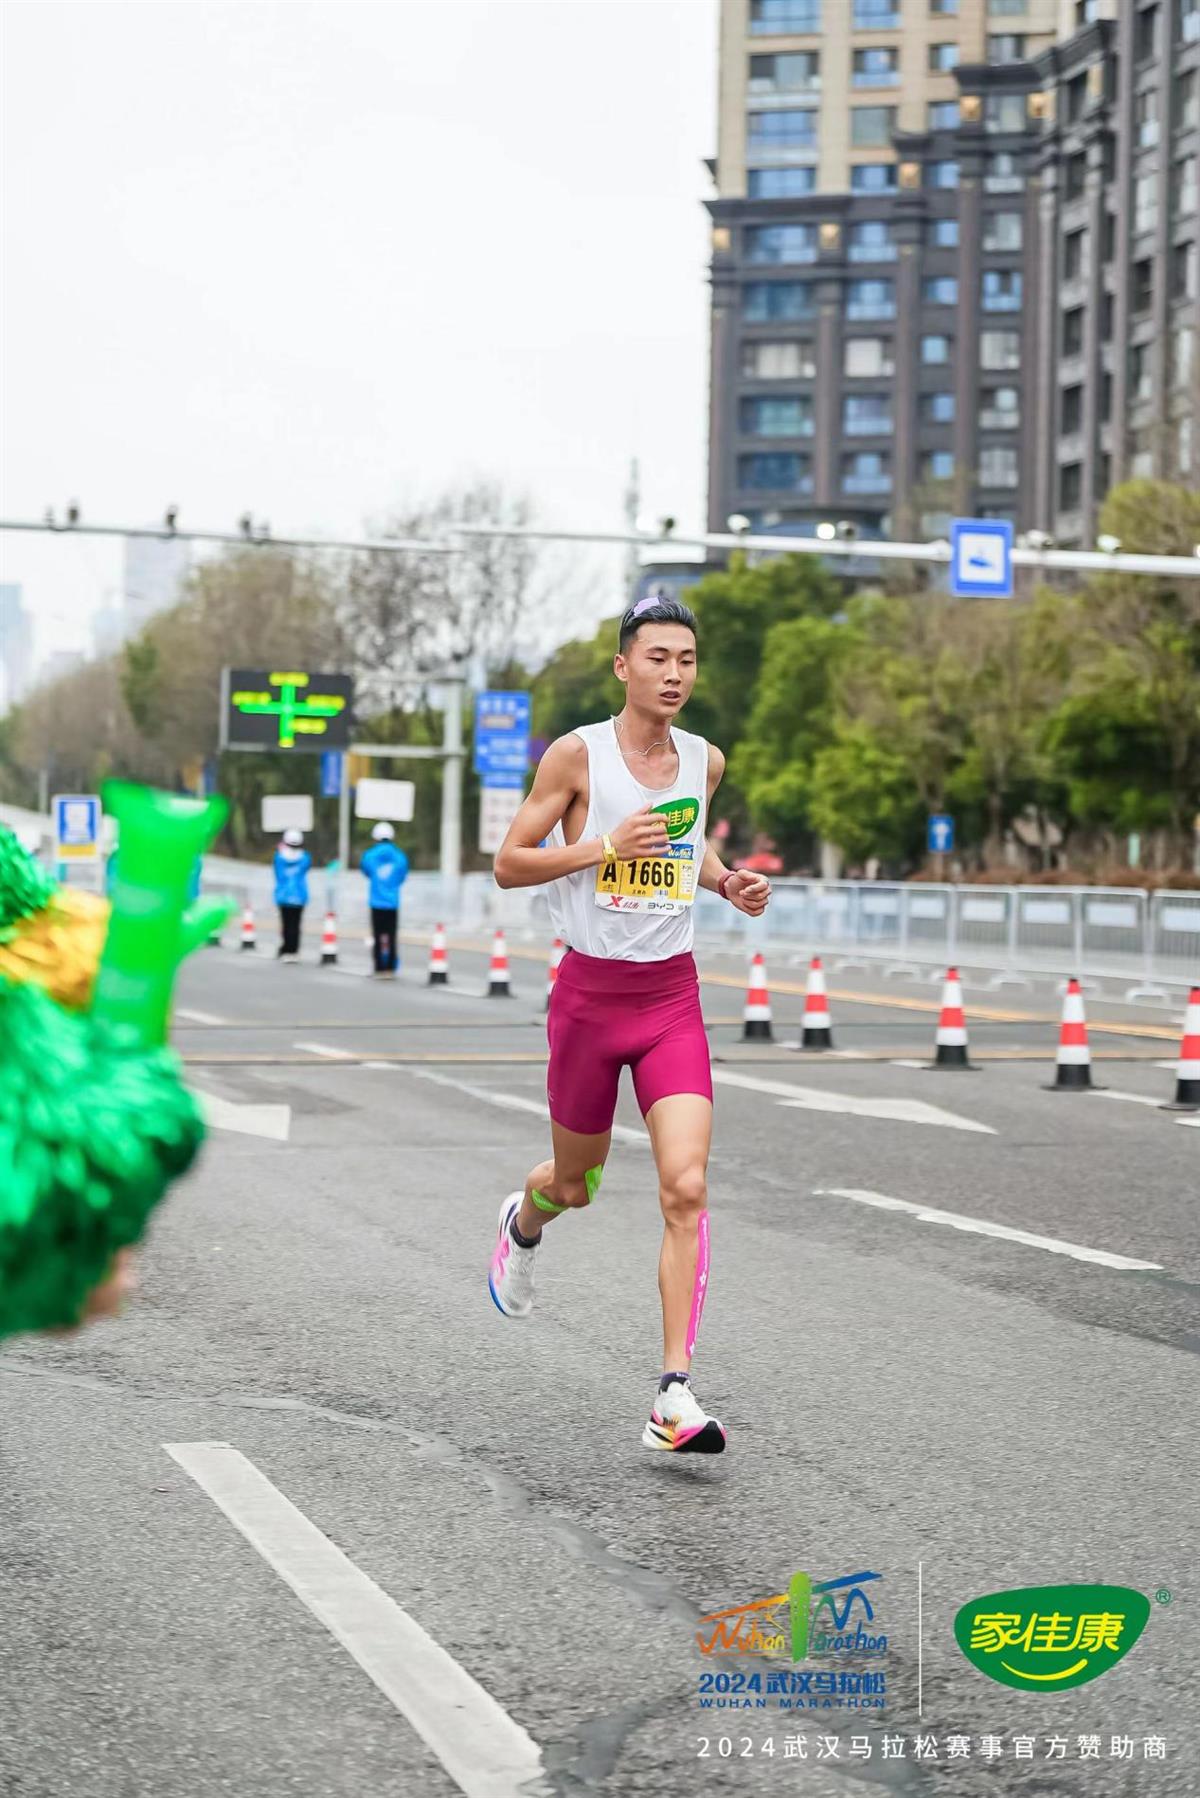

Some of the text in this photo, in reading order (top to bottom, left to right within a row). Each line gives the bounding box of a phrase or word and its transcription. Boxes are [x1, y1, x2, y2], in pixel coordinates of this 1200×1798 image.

[653, 807, 694, 828] 佳康
[602, 862, 617, 882] A
[628, 861, 675, 887] 1666
